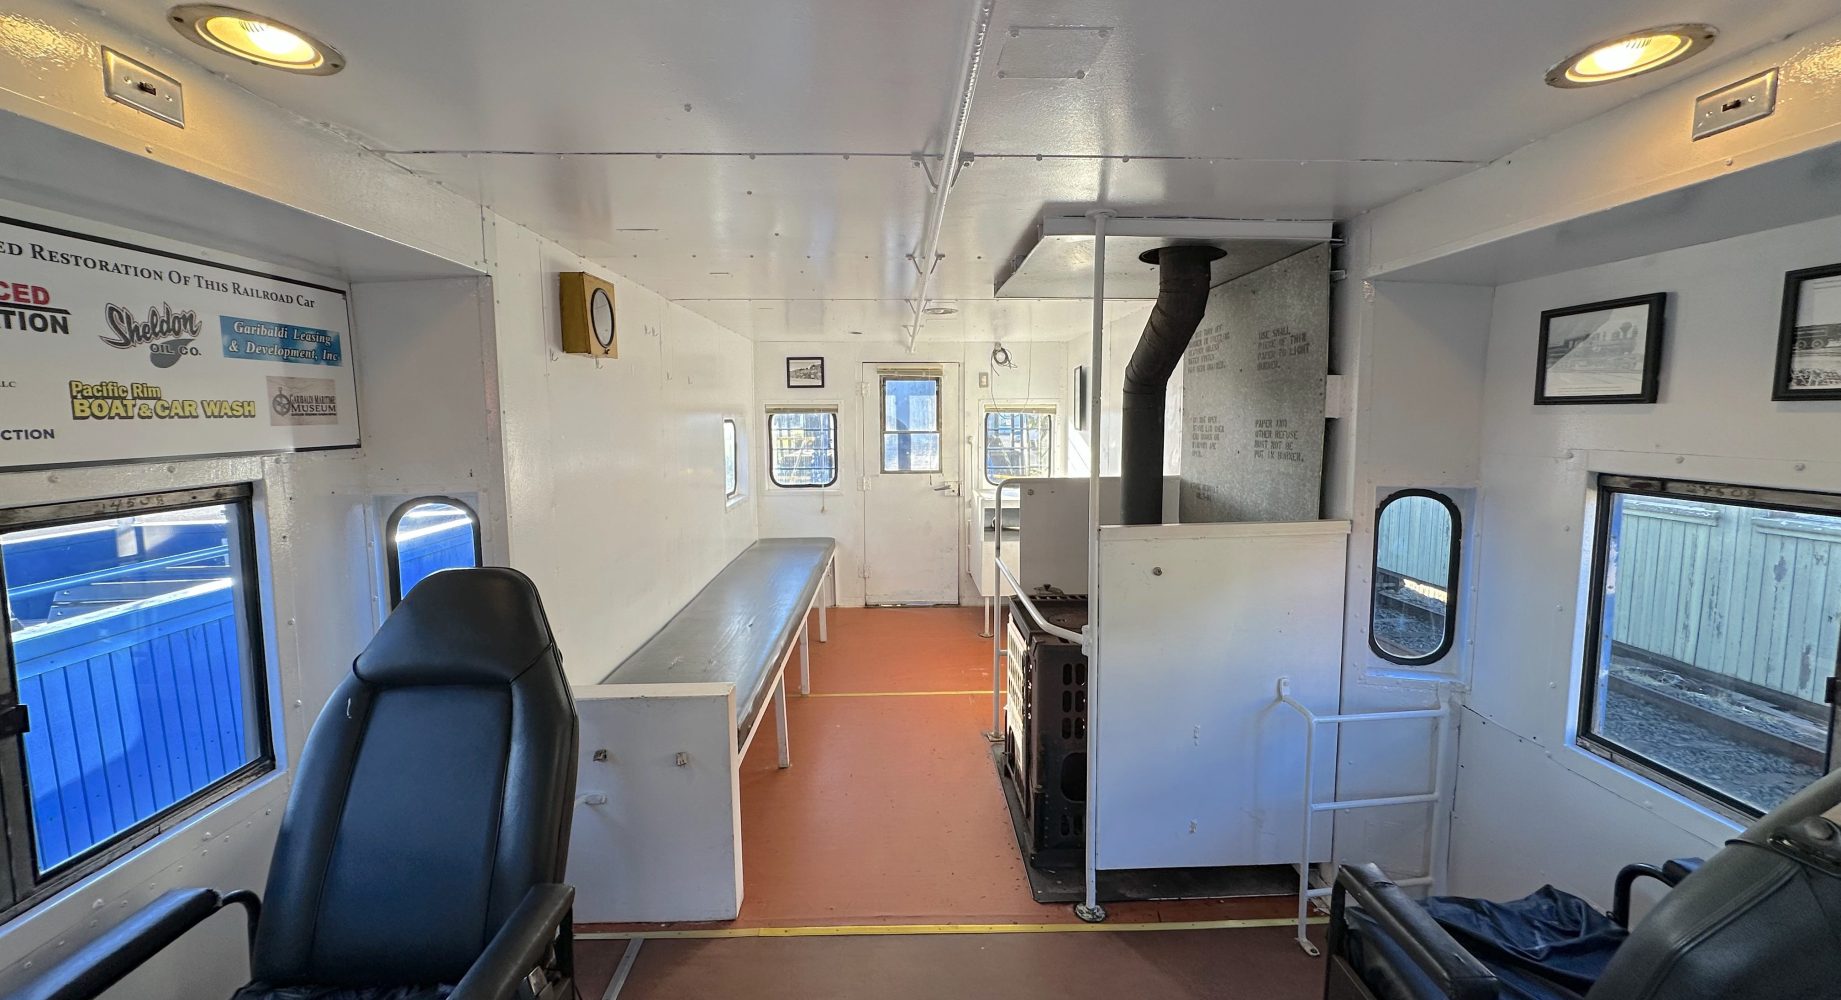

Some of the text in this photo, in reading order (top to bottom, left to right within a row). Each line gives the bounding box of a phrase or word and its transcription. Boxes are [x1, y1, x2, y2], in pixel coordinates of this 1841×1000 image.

[296, 294, 315, 308] Car
[0, 309, 70, 335] TION
[98, 301, 203, 350] Sheldon
[233, 320, 333, 346] Garibaldi Leasing
[149, 342, 176, 354] OIL
[228, 340, 239, 353] &
[245, 342, 319, 362] Development,
[69, 380, 162, 400] Pacific Rim
[72, 398, 256, 420] BOAT & CAR WASH
[291, 404, 336, 413] MUSEUM
[1255, 418, 1273, 429] PAPER
[0, 429, 55, 441] CTION
[1254, 430, 1299, 440] OTHER REFUSE
[1270, 440, 1282, 450] NOT
